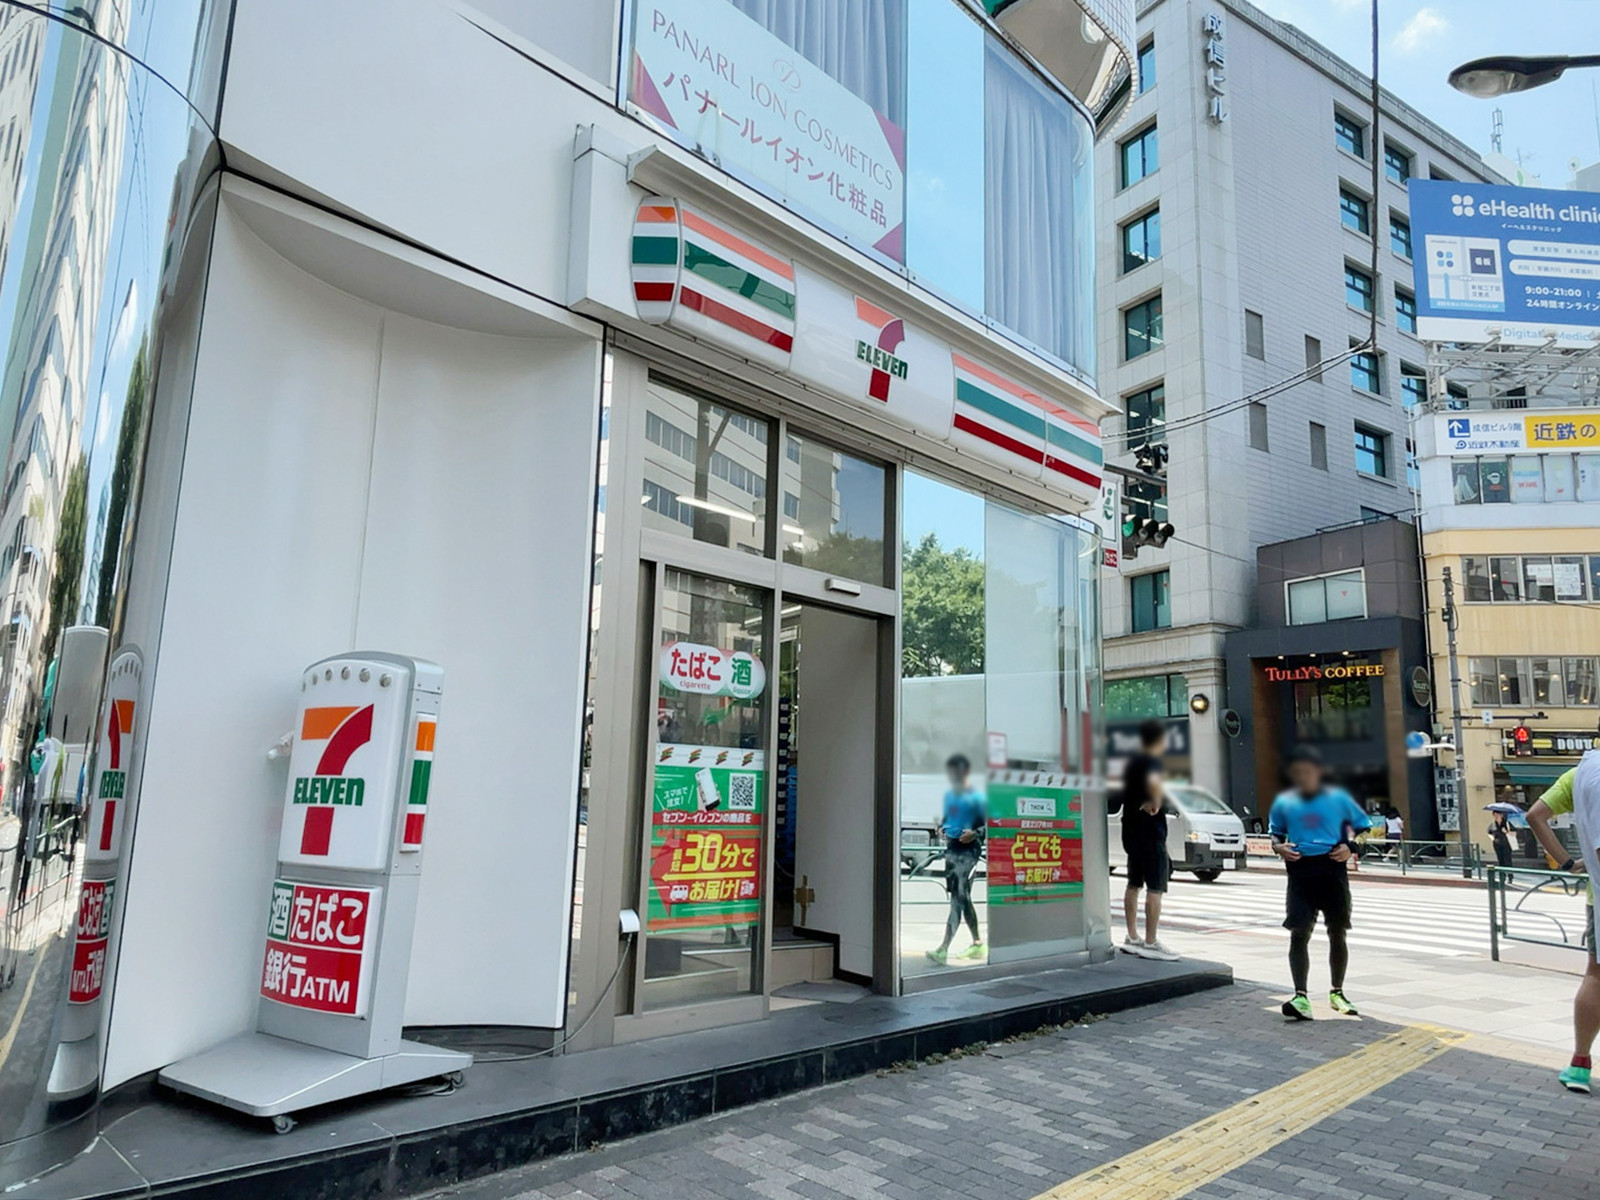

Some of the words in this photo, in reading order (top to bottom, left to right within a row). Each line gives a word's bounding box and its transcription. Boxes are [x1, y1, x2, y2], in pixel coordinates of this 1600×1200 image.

[652, 8, 740, 89] PANARL
[750, 76, 788, 121] ION
[794, 109, 894, 191] COSMETICS
[662, 72, 887, 228] パナールイオン化粧品
[1479, 200, 1555, 221] eHealth
[1525, 286, 1582, 297] 9:00-21:00
[671, 648, 721, 681] たばこ
[731, 657, 752, 686] 酒
[1324, 664, 1385, 678] COFFEE
[300, 704, 374, 856] 7
[681, 834, 755, 872] 30分で
[1011, 835, 1062, 860] どこでも
[269, 887, 292, 936] 酒
[291, 891, 363, 945] たばこ
[264, 948, 350, 1004] 銀行ATM
